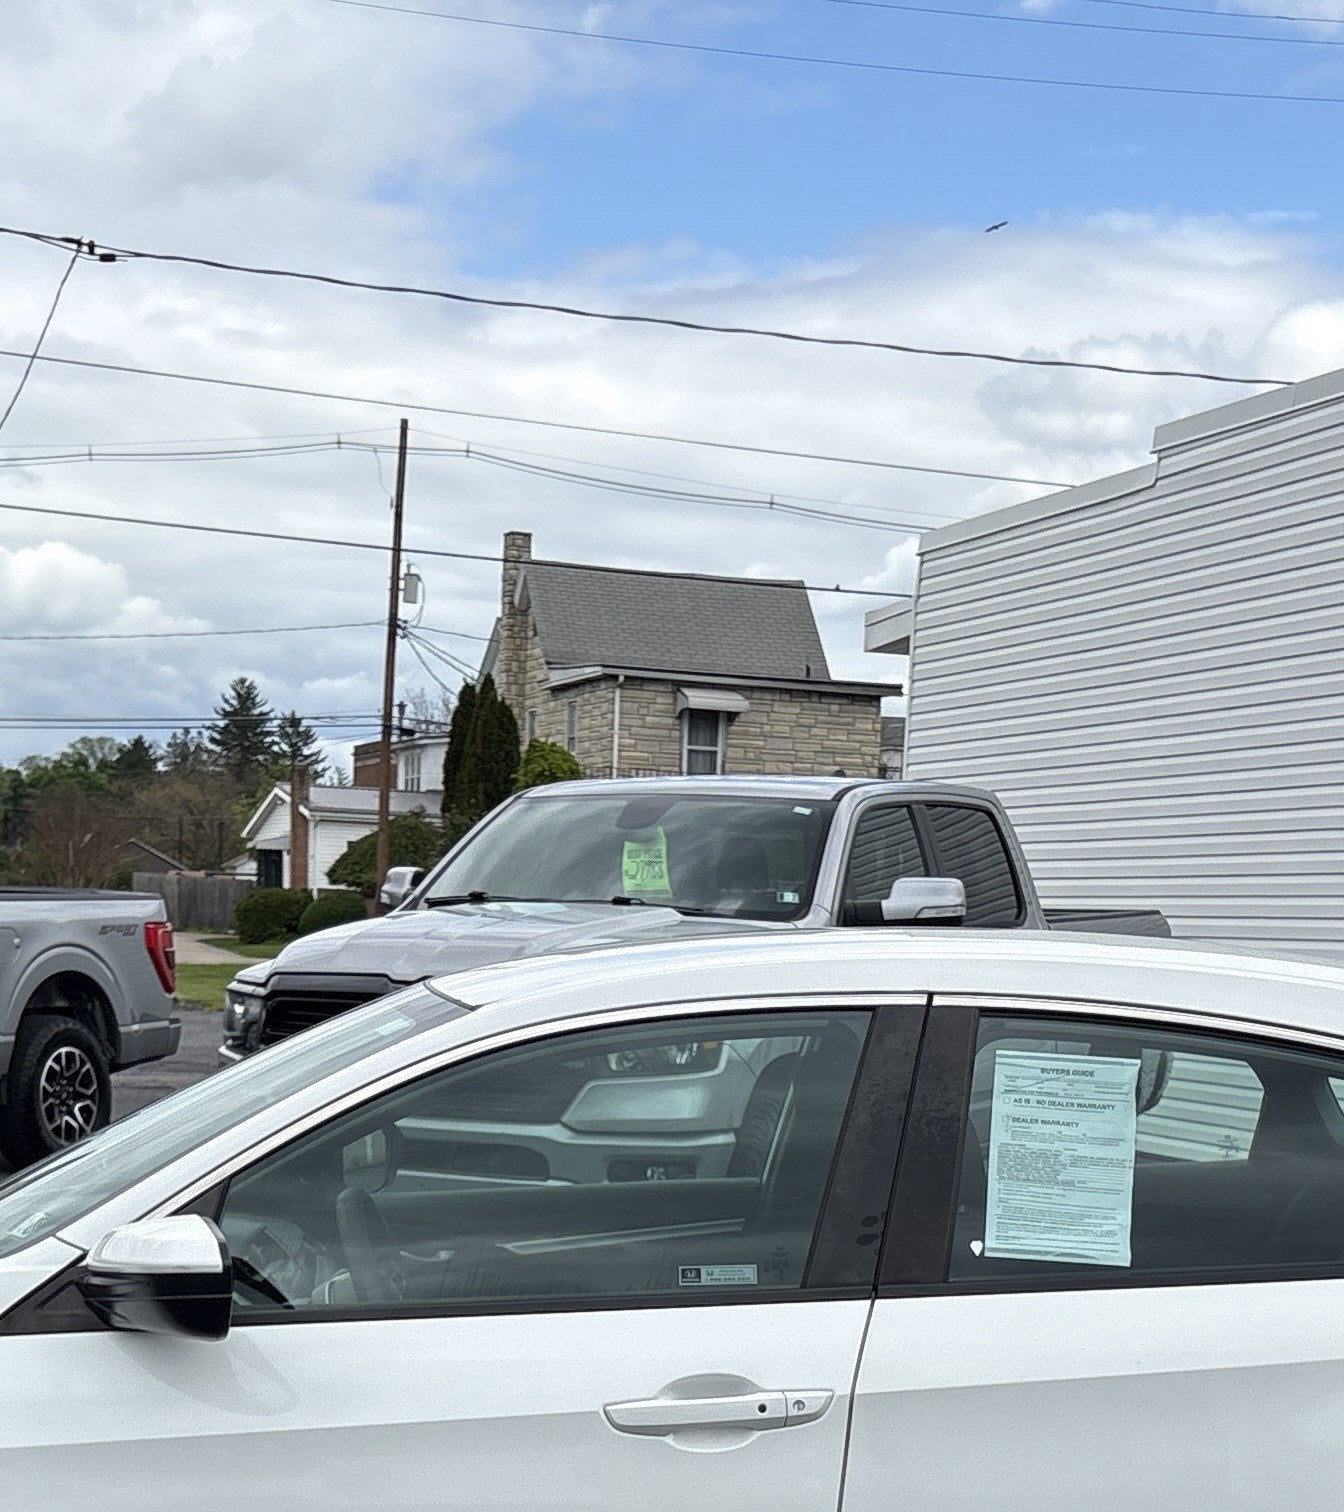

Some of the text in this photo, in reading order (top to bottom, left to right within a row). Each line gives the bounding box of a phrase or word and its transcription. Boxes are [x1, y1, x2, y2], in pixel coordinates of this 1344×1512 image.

[1040, 1067, 1095, 1078] BUYERS GUIDE
[1047, 1101, 1075, 1109] DEALER
[1076, 1103, 1117, 1111] WARRANTY
[1011, 1116, 1080, 1128] DEALER WARRANTY
